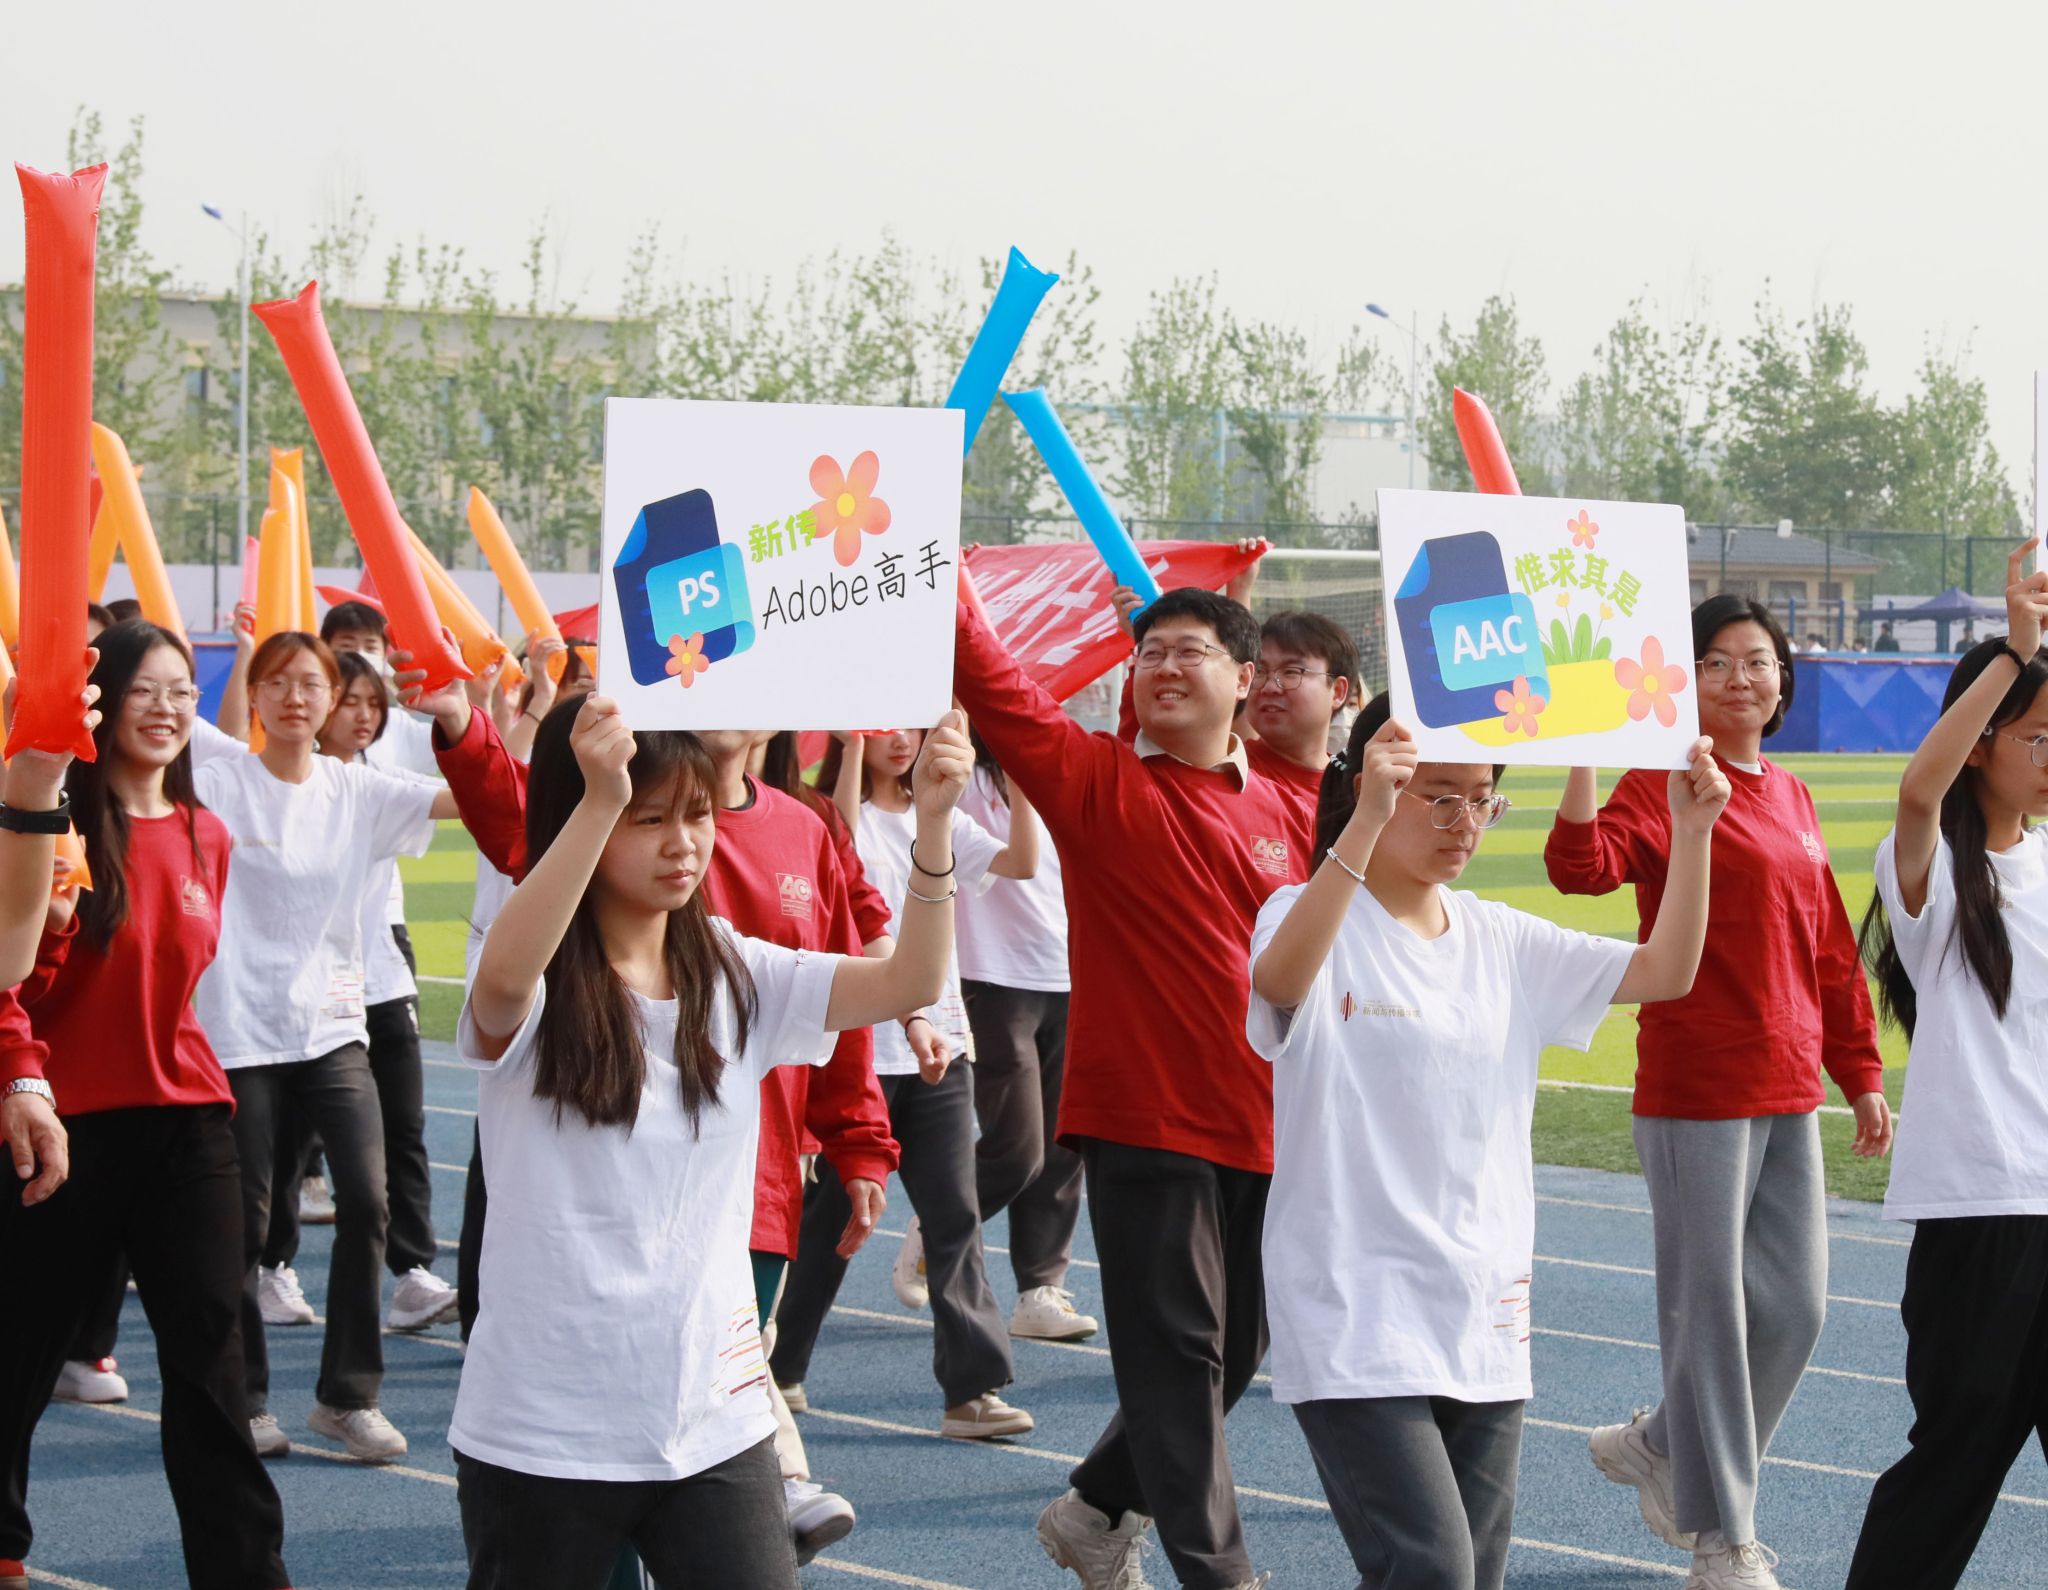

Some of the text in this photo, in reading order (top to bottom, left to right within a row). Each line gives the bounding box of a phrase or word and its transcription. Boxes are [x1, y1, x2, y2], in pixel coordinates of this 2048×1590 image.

[748, 509, 817, 564] 新传
[678, 570, 720, 615] PS
[762, 539, 951, 630] Adobe高手
[1514, 547, 1643, 617] 惟求其是
[1452, 615, 1528, 664] AAC
